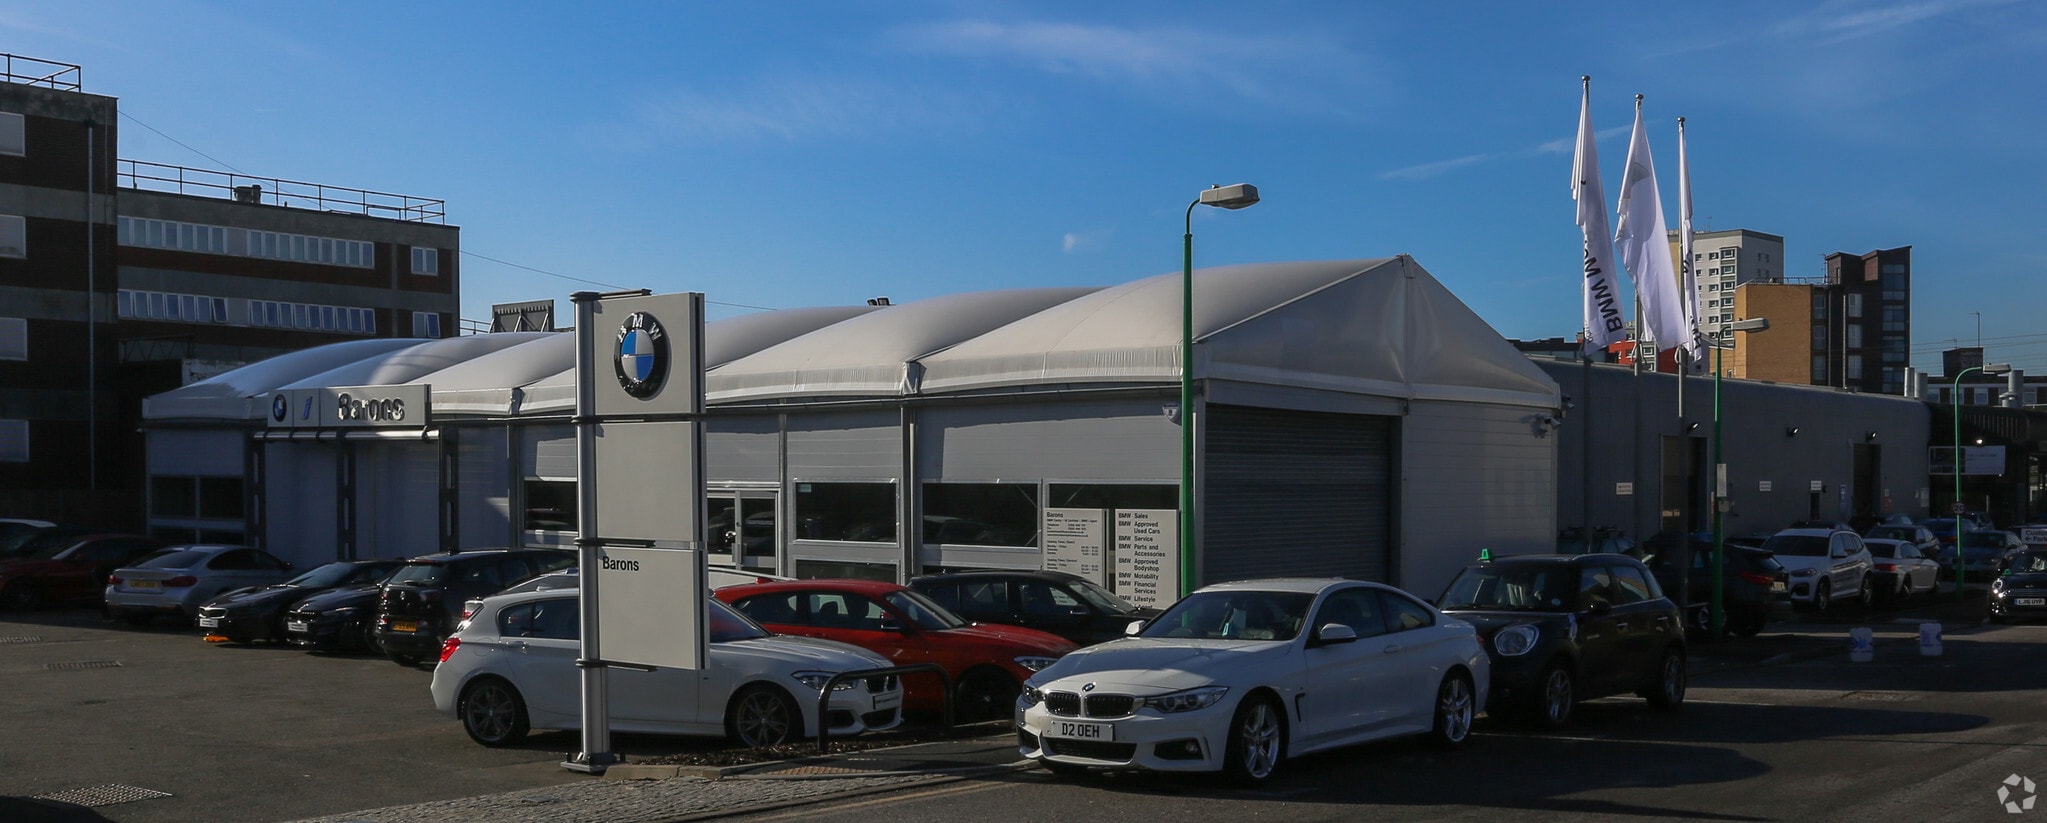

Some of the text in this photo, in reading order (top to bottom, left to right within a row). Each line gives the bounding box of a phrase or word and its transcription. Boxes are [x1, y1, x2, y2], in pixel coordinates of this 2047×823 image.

[617, 313, 662, 343] BMW
[338, 393, 405, 421] Barons
[602, 556, 639, 571] Barons
[1062, 723, 1100, 738] D2 OEH
